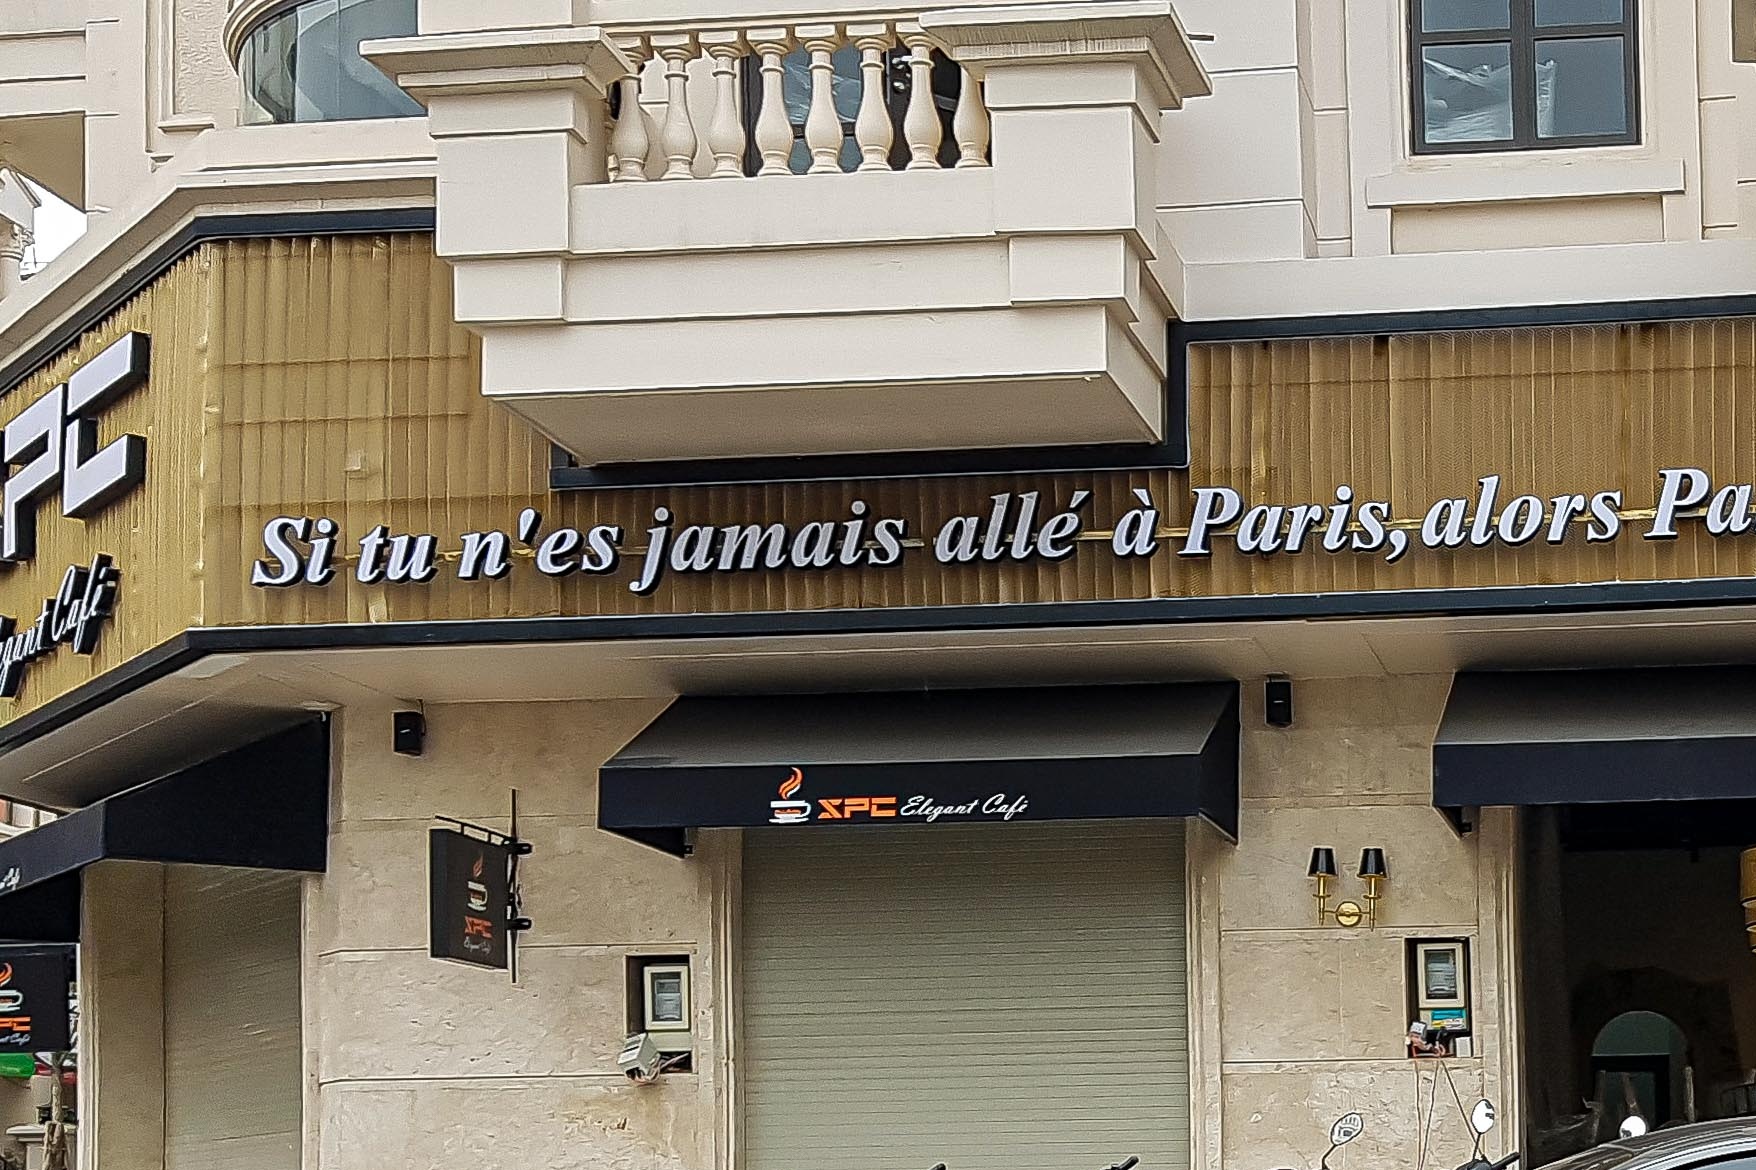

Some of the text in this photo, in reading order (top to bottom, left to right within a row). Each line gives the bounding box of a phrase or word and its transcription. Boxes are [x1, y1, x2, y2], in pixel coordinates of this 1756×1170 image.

[0, 331, 134, 560] PC
[251, 515, 334, 587] Si
[357, 521, 434, 583] tu
[458, 507, 622, 582] n'es
[630, 500, 906, 596] jamais
[934, 488, 1092, 565] allé
[1112, 488, 1160, 557] à
[1178, 484, 1406, 564] Paris,
[1420, 474, 1622, 546] alors
[817, 793, 1029, 823] SPC Elegant Café
